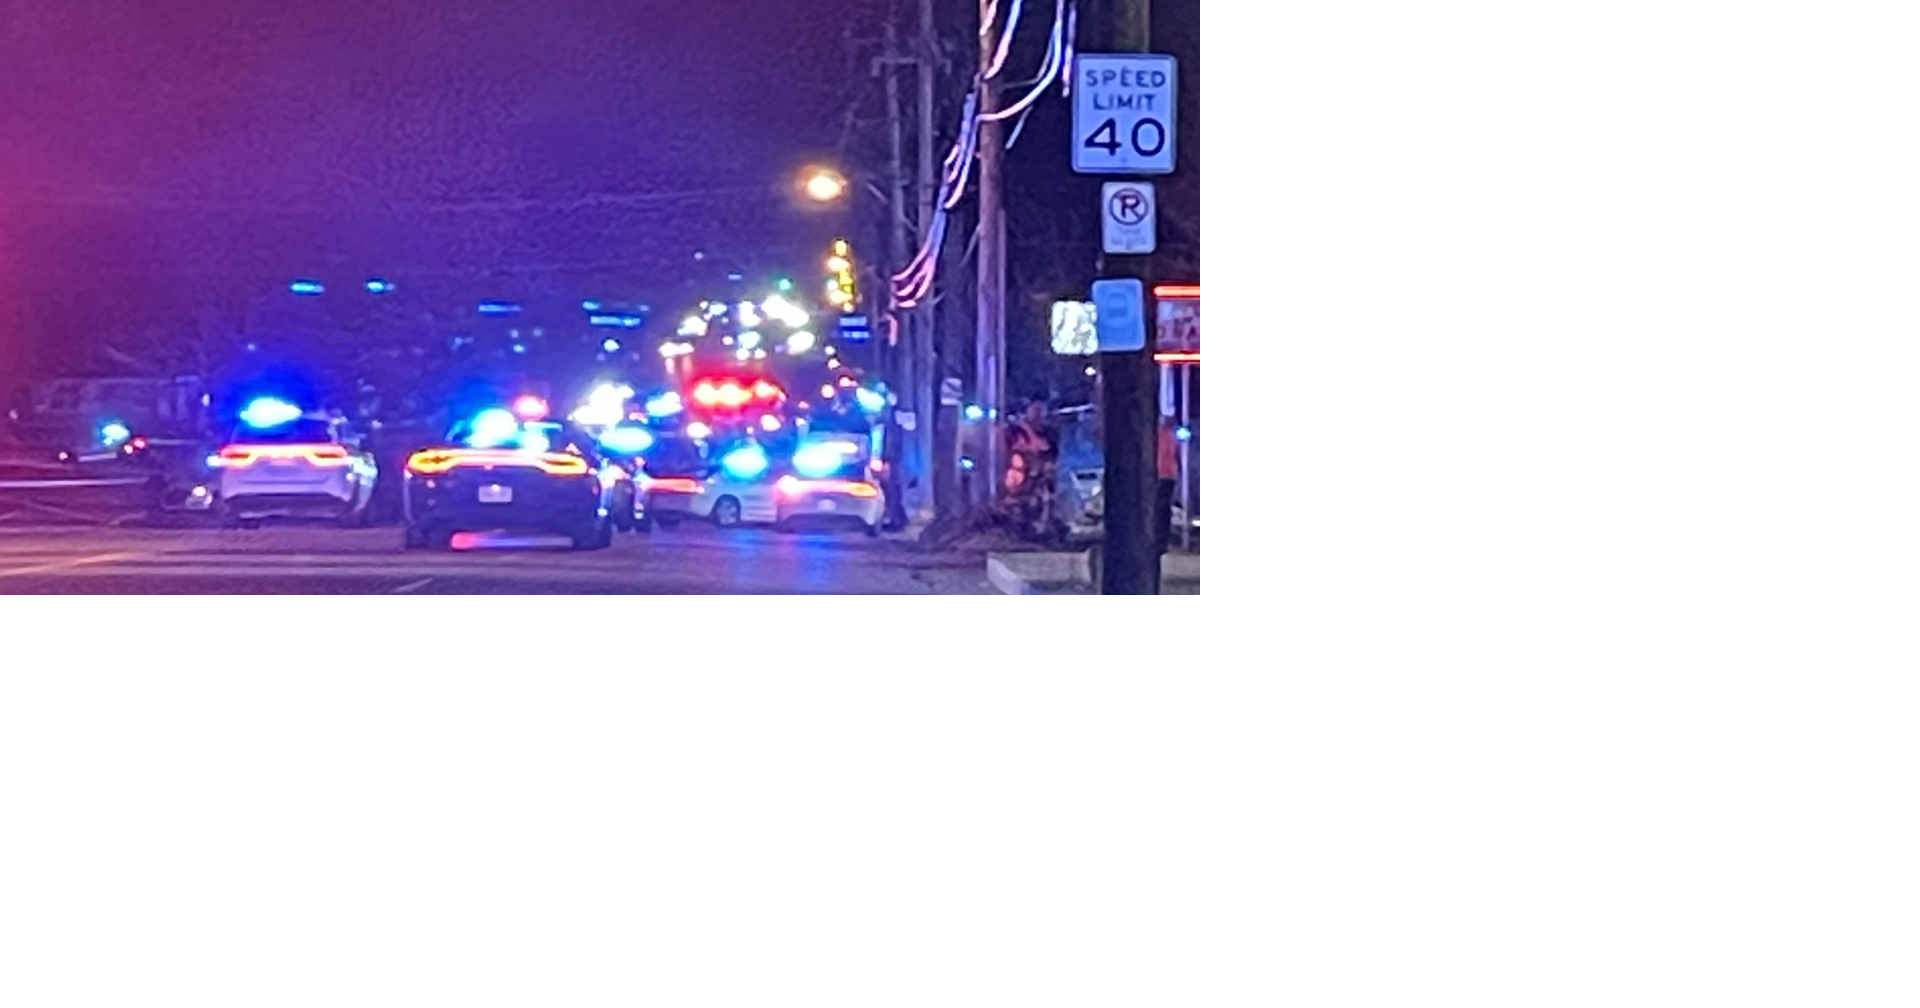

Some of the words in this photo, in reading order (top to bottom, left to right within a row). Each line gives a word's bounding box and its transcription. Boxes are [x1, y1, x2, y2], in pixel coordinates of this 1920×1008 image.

[1085, 68, 1166, 88] SPEED
[1093, 93, 1156, 111] LIMIT
[1084, 117, 1165, 157] 40
